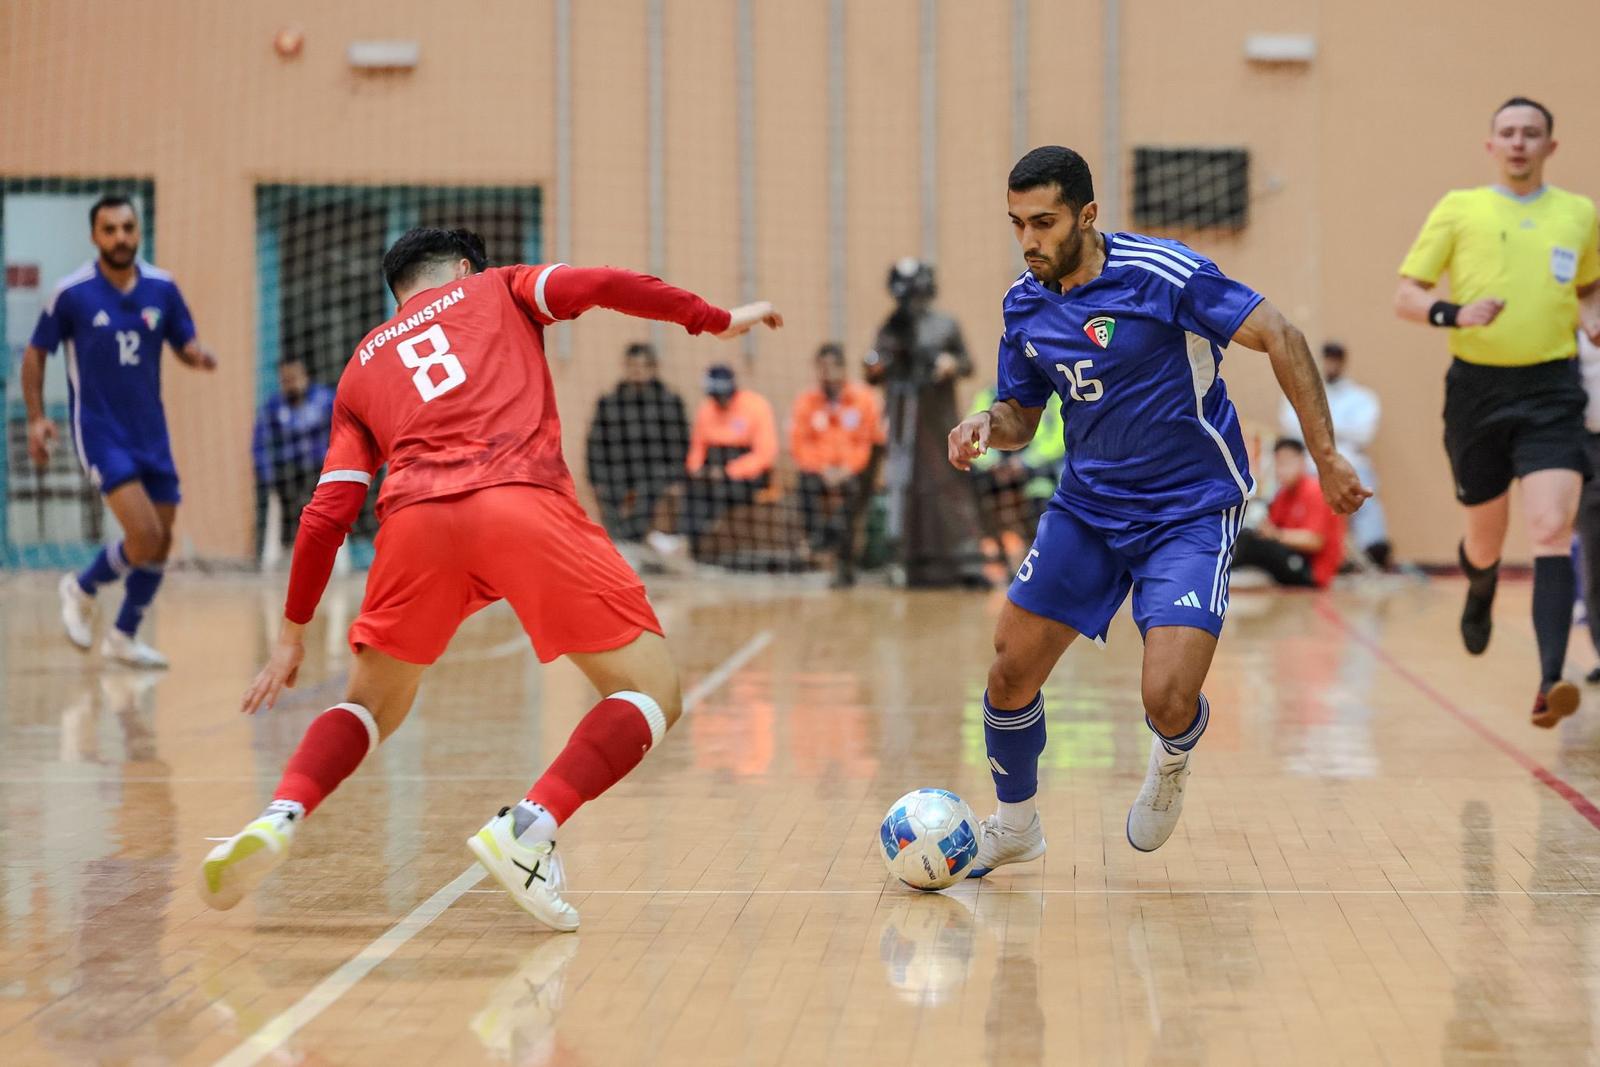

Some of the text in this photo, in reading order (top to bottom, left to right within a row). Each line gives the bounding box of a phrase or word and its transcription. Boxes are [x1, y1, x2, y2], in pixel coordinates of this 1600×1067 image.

[115, 330, 141, 366] 12
[359, 286, 466, 367] AFGHANISTAN
[396, 323, 467, 403] 8
[1055, 359, 1104, 402] 15
